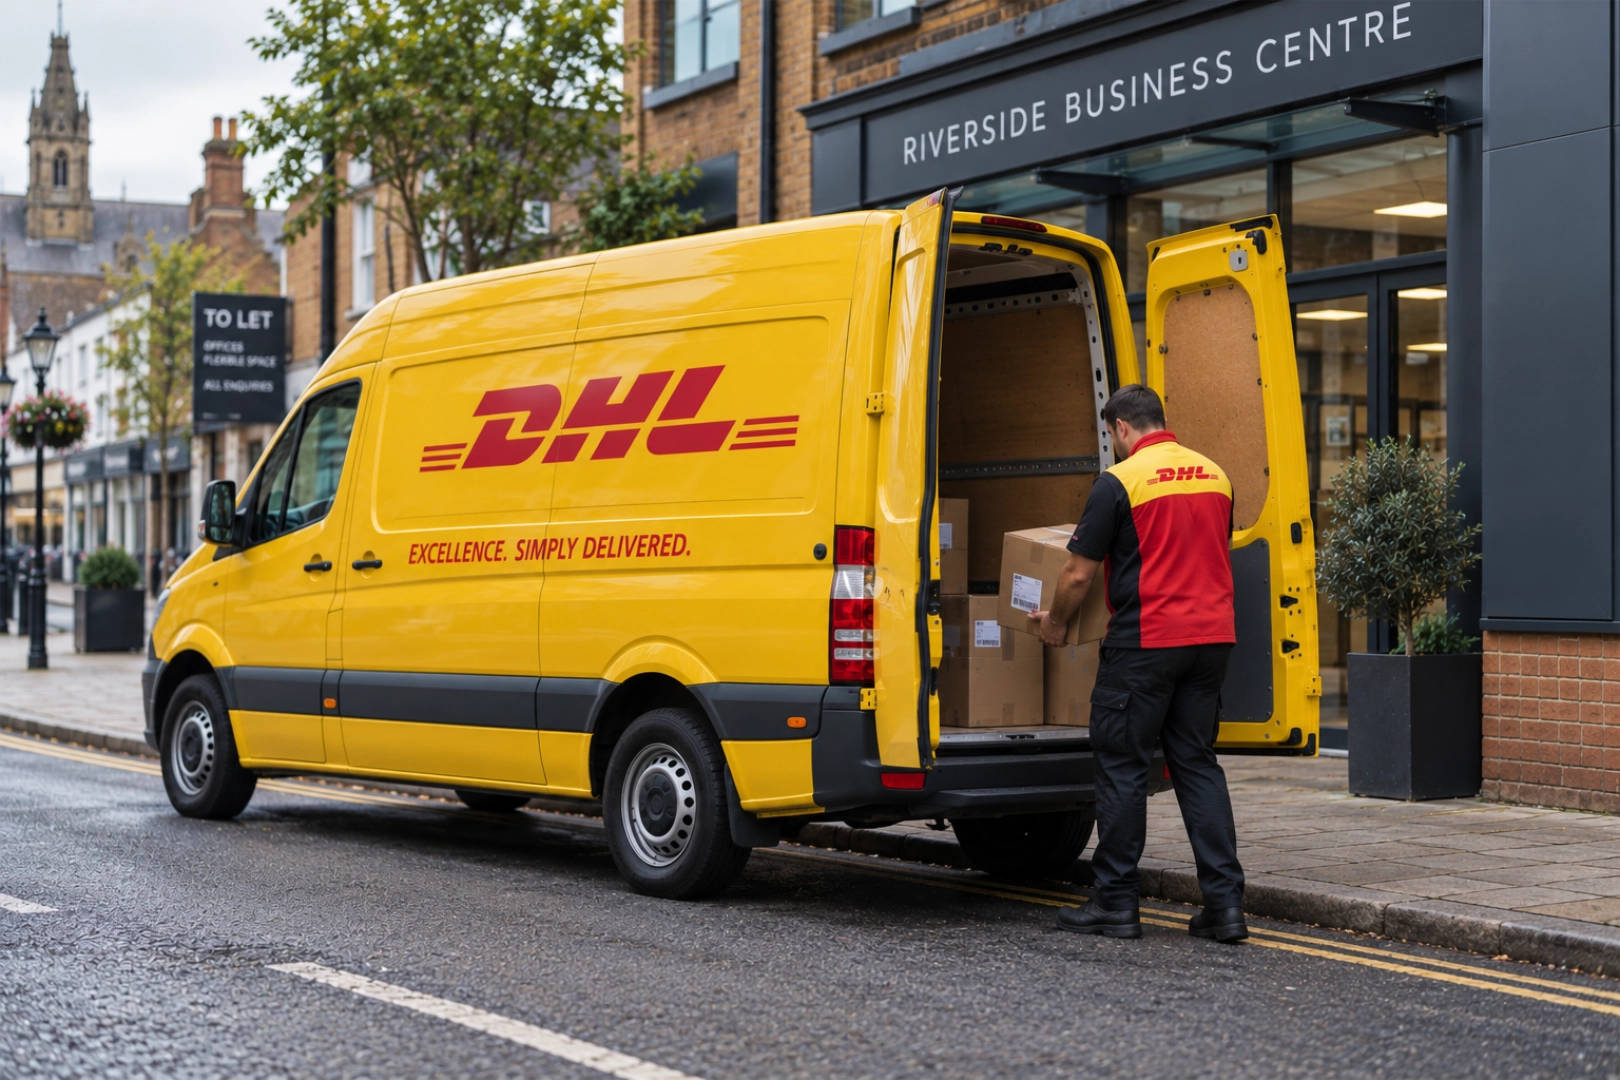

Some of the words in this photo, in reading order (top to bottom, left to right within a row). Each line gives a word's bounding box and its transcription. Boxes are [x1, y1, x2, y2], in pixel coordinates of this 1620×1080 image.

[903, 100, 1047, 165] RIVERSIDE
[1065, 50, 1233, 123] BUSINESS
[1256, 2, 1413, 73] CENTRE
[203, 308, 232, 328] TO
[237, 309, 273, 330] LET
[203, 379, 221, 392] ALL
[461, 365, 736, 469] DHL
[1156, 466, 1210, 482] DHL
[408, 540, 508, 564] EXCELLENCE.
[514, 537, 579, 561] SIMPLY
[582, 533, 691, 559] DELIVERED.
